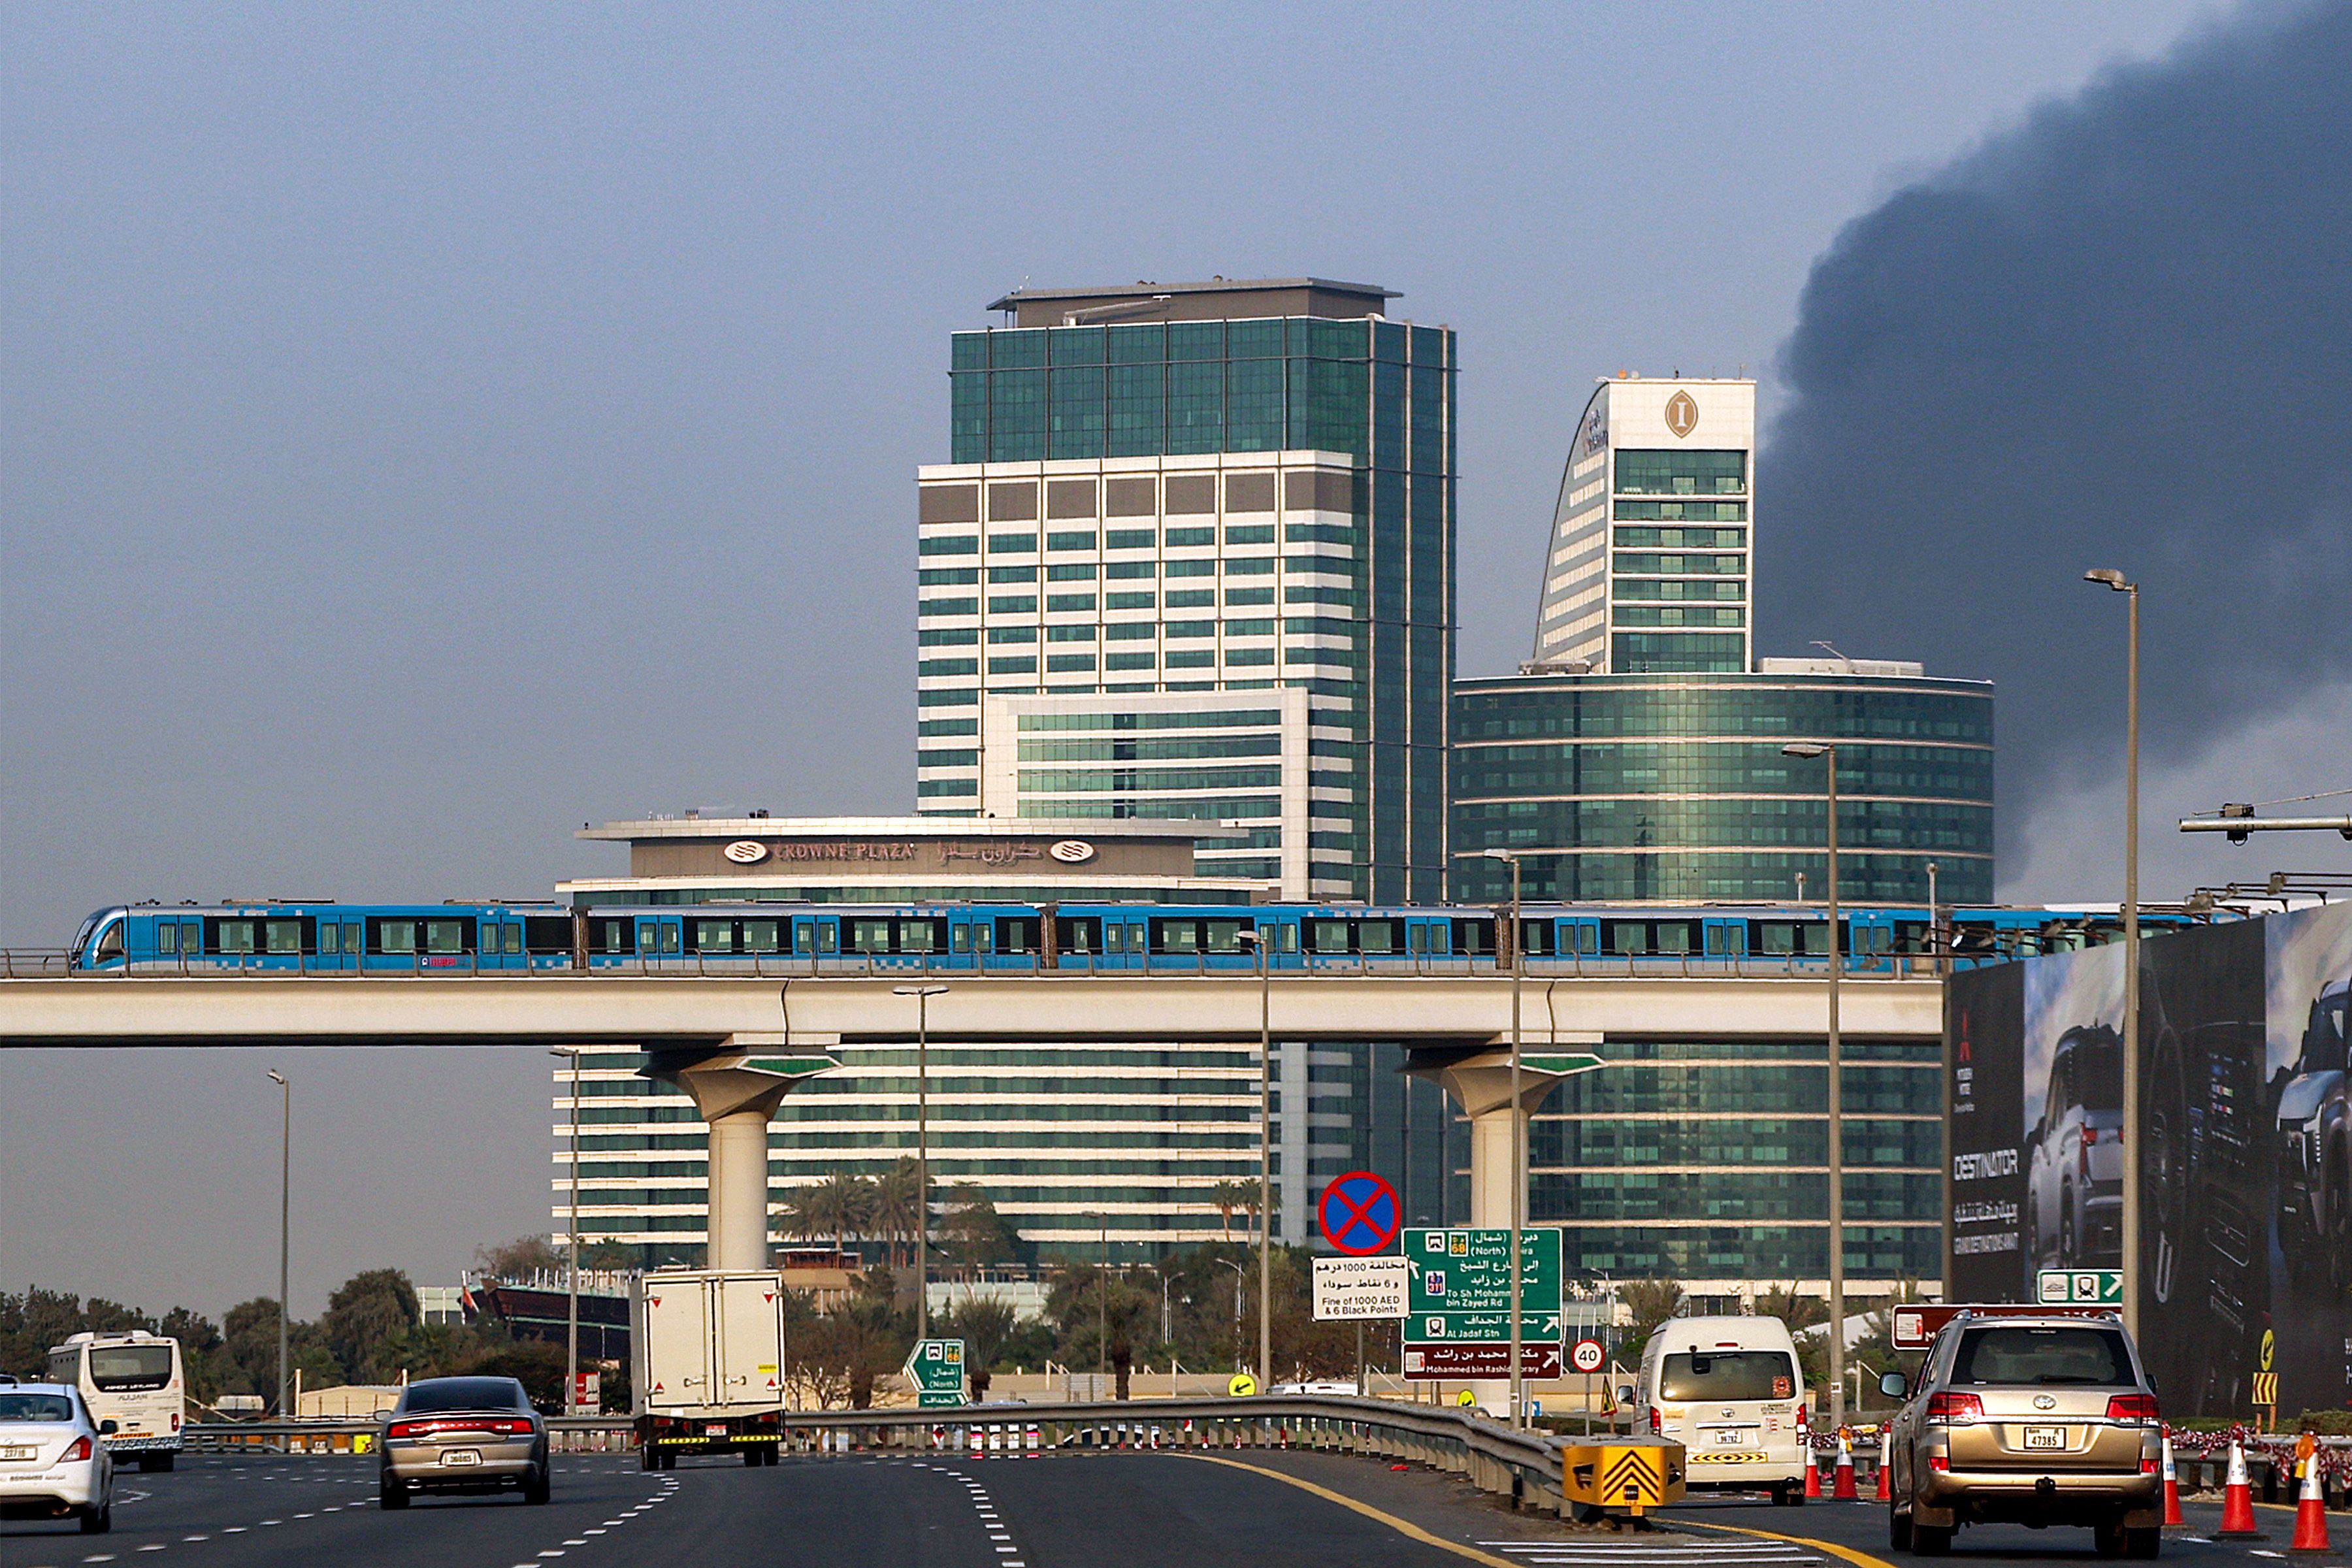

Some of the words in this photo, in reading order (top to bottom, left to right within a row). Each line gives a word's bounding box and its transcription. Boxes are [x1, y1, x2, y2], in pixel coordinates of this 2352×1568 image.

[774, 843, 848, 858] CROWNE
[857, 843, 913, 858] PLAZA
[937, 840, 978, 862] بلازا
[981, 841, 1039, 862] كراون
[1519, 1233, 1539, 1244] دير
[1450, 1243, 1466, 1254] 68
[1471, 1247, 1507, 1257] (North)
[1316, 1264, 1341, 1274] درهم
[1343, 1263, 1366, 1272] 1000
[1369, 1261, 1405, 1269] مخالفة
[1460, 1260, 1489, 1272] الشيخ
[1493, 1260, 1512, 1272] ارع
[1323, 1279, 1352, 1290] سوداء
[1356, 1279, 1382, 1288] نقاط
[1384, 1279, 1391, 1288] 6
[1492, 1277, 1505, 1286] بن
[1428, 1283, 1443, 1292] 311
[1446, 1289, 1458, 1298] To
[1460, 1289, 1472, 1298] Sh
[1475, 1289, 1524, 1298] Mohammd
[1343, 1297, 1352, 1305] of
[1354, 1296, 1378, 1305] 1000
[1380, 1296, 1400, 1305] AED
[1446, 1298, 1460, 1307] bin
[1462, 1299, 1488, 1309] Zayed
[1490, 1298, 1503, 1307] Rd
[1333, 1307, 1341, 1315] 6
[1342, 1306, 1369, 1315] Black
[1370, 1305, 1398, 1314] Points
[1446, 1330, 1456, 1338] Al
[1458, 1329, 1482, 1337] Jadaf
[1484, 1329, 1500, 1337] Stn
[1433, 1348, 1459, 1361] راشد
[1461, 1352, 1475, 1361] بن
[1477, 1349, 1507, 1359] محمد
[1577, 1348, 1597, 1362] 40
[1426, 1365, 1470, 1373] Mohammed
[2031, 1435, 2057, 1446] 47385
